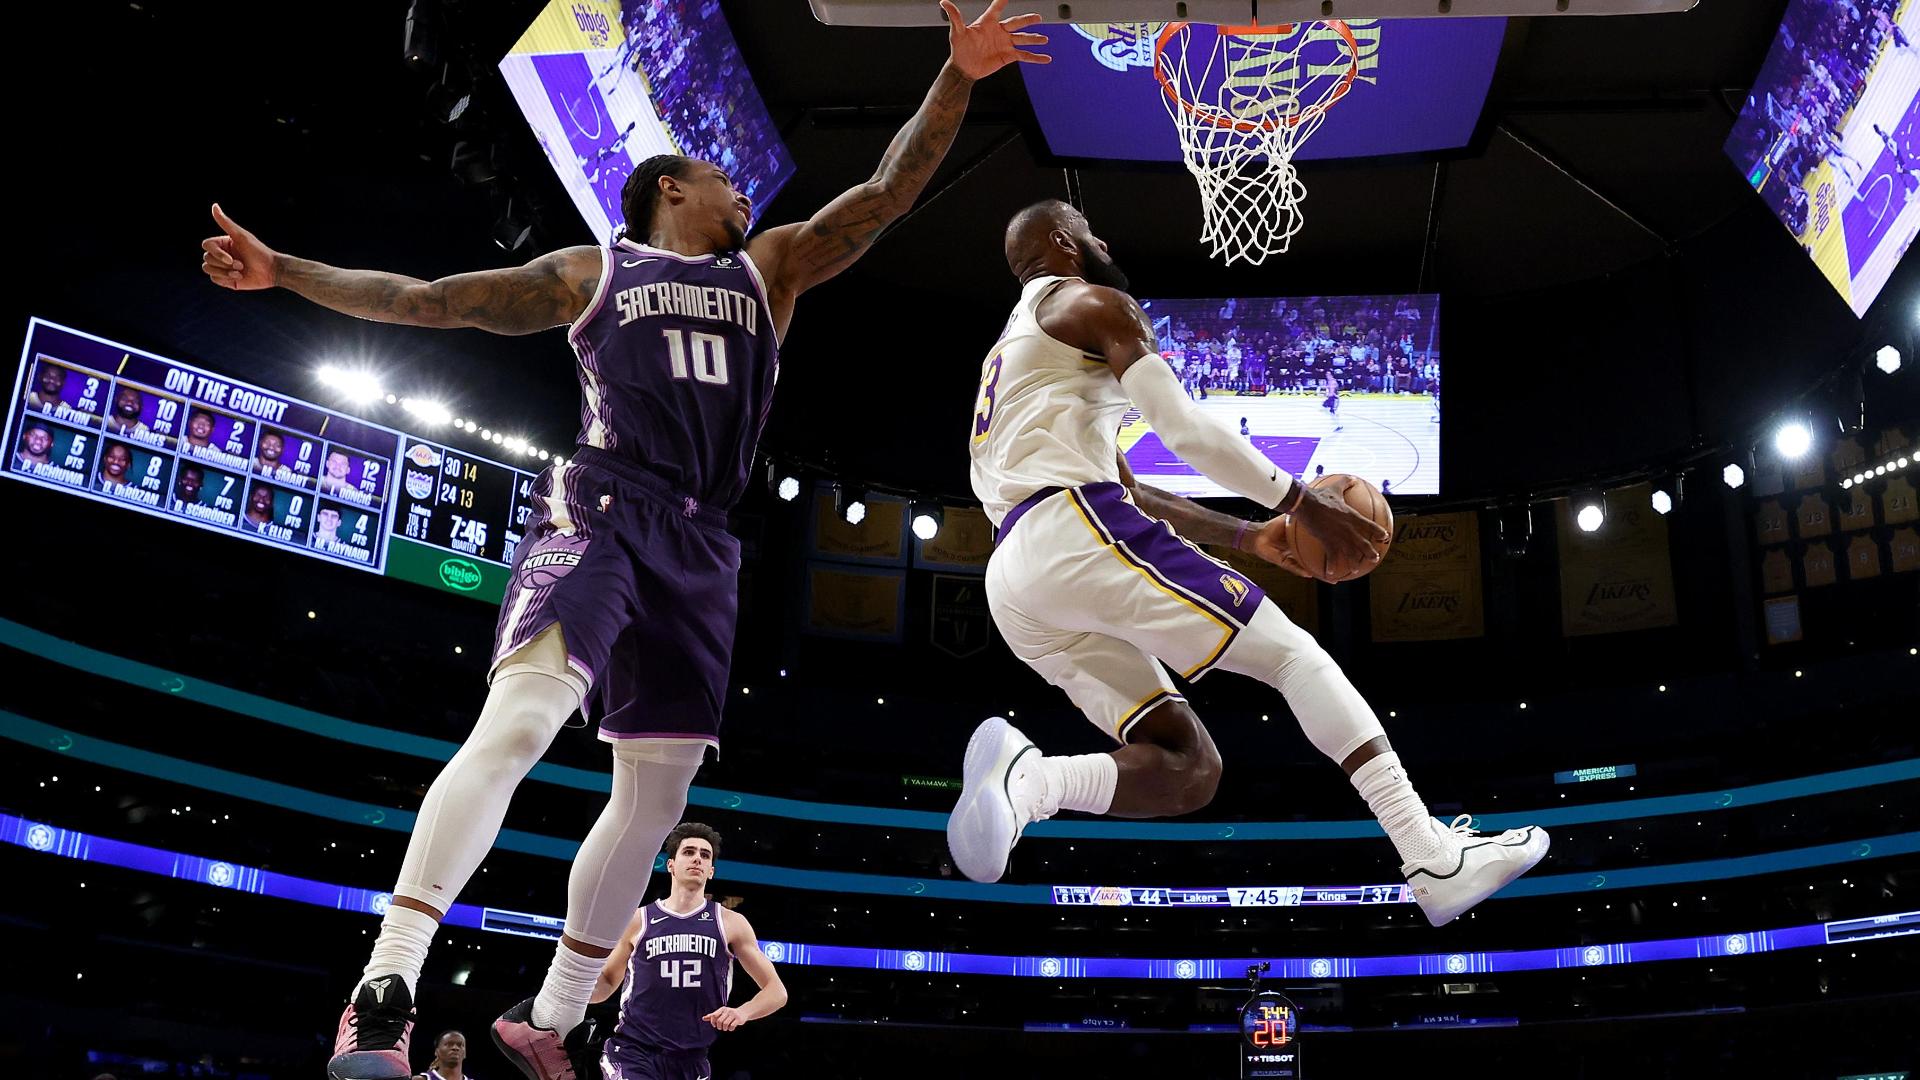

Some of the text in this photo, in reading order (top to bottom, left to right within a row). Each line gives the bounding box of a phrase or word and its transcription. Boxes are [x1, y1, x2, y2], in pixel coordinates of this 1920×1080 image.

[571, 2, 610, 42] bibigo
[615, 281, 757, 336] SACRAMENTO
[662, 329, 730, 386] 10
[83, 377, 99, 398] 3
[164, 368, 289, 423] ON THE COURT
[78, 397, 97, 412] PTS
[156, 398, 177, 421] 10
[153, 419, 172, 434] PTS
[230, 422, 244, 442] 2
[70, 434, 87, 456] 5
[130, 427, 166, 448] JAMES
[225, 440, 243, 455] PTS
[298, 441, 313, 462] 0
[64, 455, 84, 470] PTS
[147, 456, 162, 477] 8
[294, 460, 311, 475] PTS
[362, 460, 380, 481] 12
[444, 456, 478, 482] 30 14
[142, 476, 160, 491] PTS
[221, 476, 235, 496] 7
[274, 468, 310, 488] SMART
[360, 480, 376, 493] PTS
[215, 496, 233, 510] PTS
[289, 495, 303, 516] 0
[441, 483, 457, 504] 24
[460, 488, 474, 509] 13
[285, 514, 302, 529] PTS
[355, 514, 369, 535] 4
[450, 514, 487, 546] 7:45
[269, 525, 293, 541] ELLIS
[351, 533, 367, 547] PTS
[480, 547, 486, 557] 2
[521, 553, 582, 571] KINGS
[444, 564, 479, 584] bibigo
[1573, 765, 1616, 777] AMERICAN
[1579, 772, 1617, 782] EXPRESS
[1061, 894, 1086, 903] 6 3
[1139, 889, 1279, 905] 44 Lakers 7:45
[1291, 894, 1298, 905] 2
[1316, 891, 1347, 902] Kings
[1371, 887, 1393, 903] 37
[645, 934, 718, 960] SACRAMENTO
[660, 960, 702, 988] 42
[1258, 1006, 1290, 1020] 7:44
[1254, 1020, 1286, 1045] 20
[1260, 1054, 1295, 1063] TISSOT
